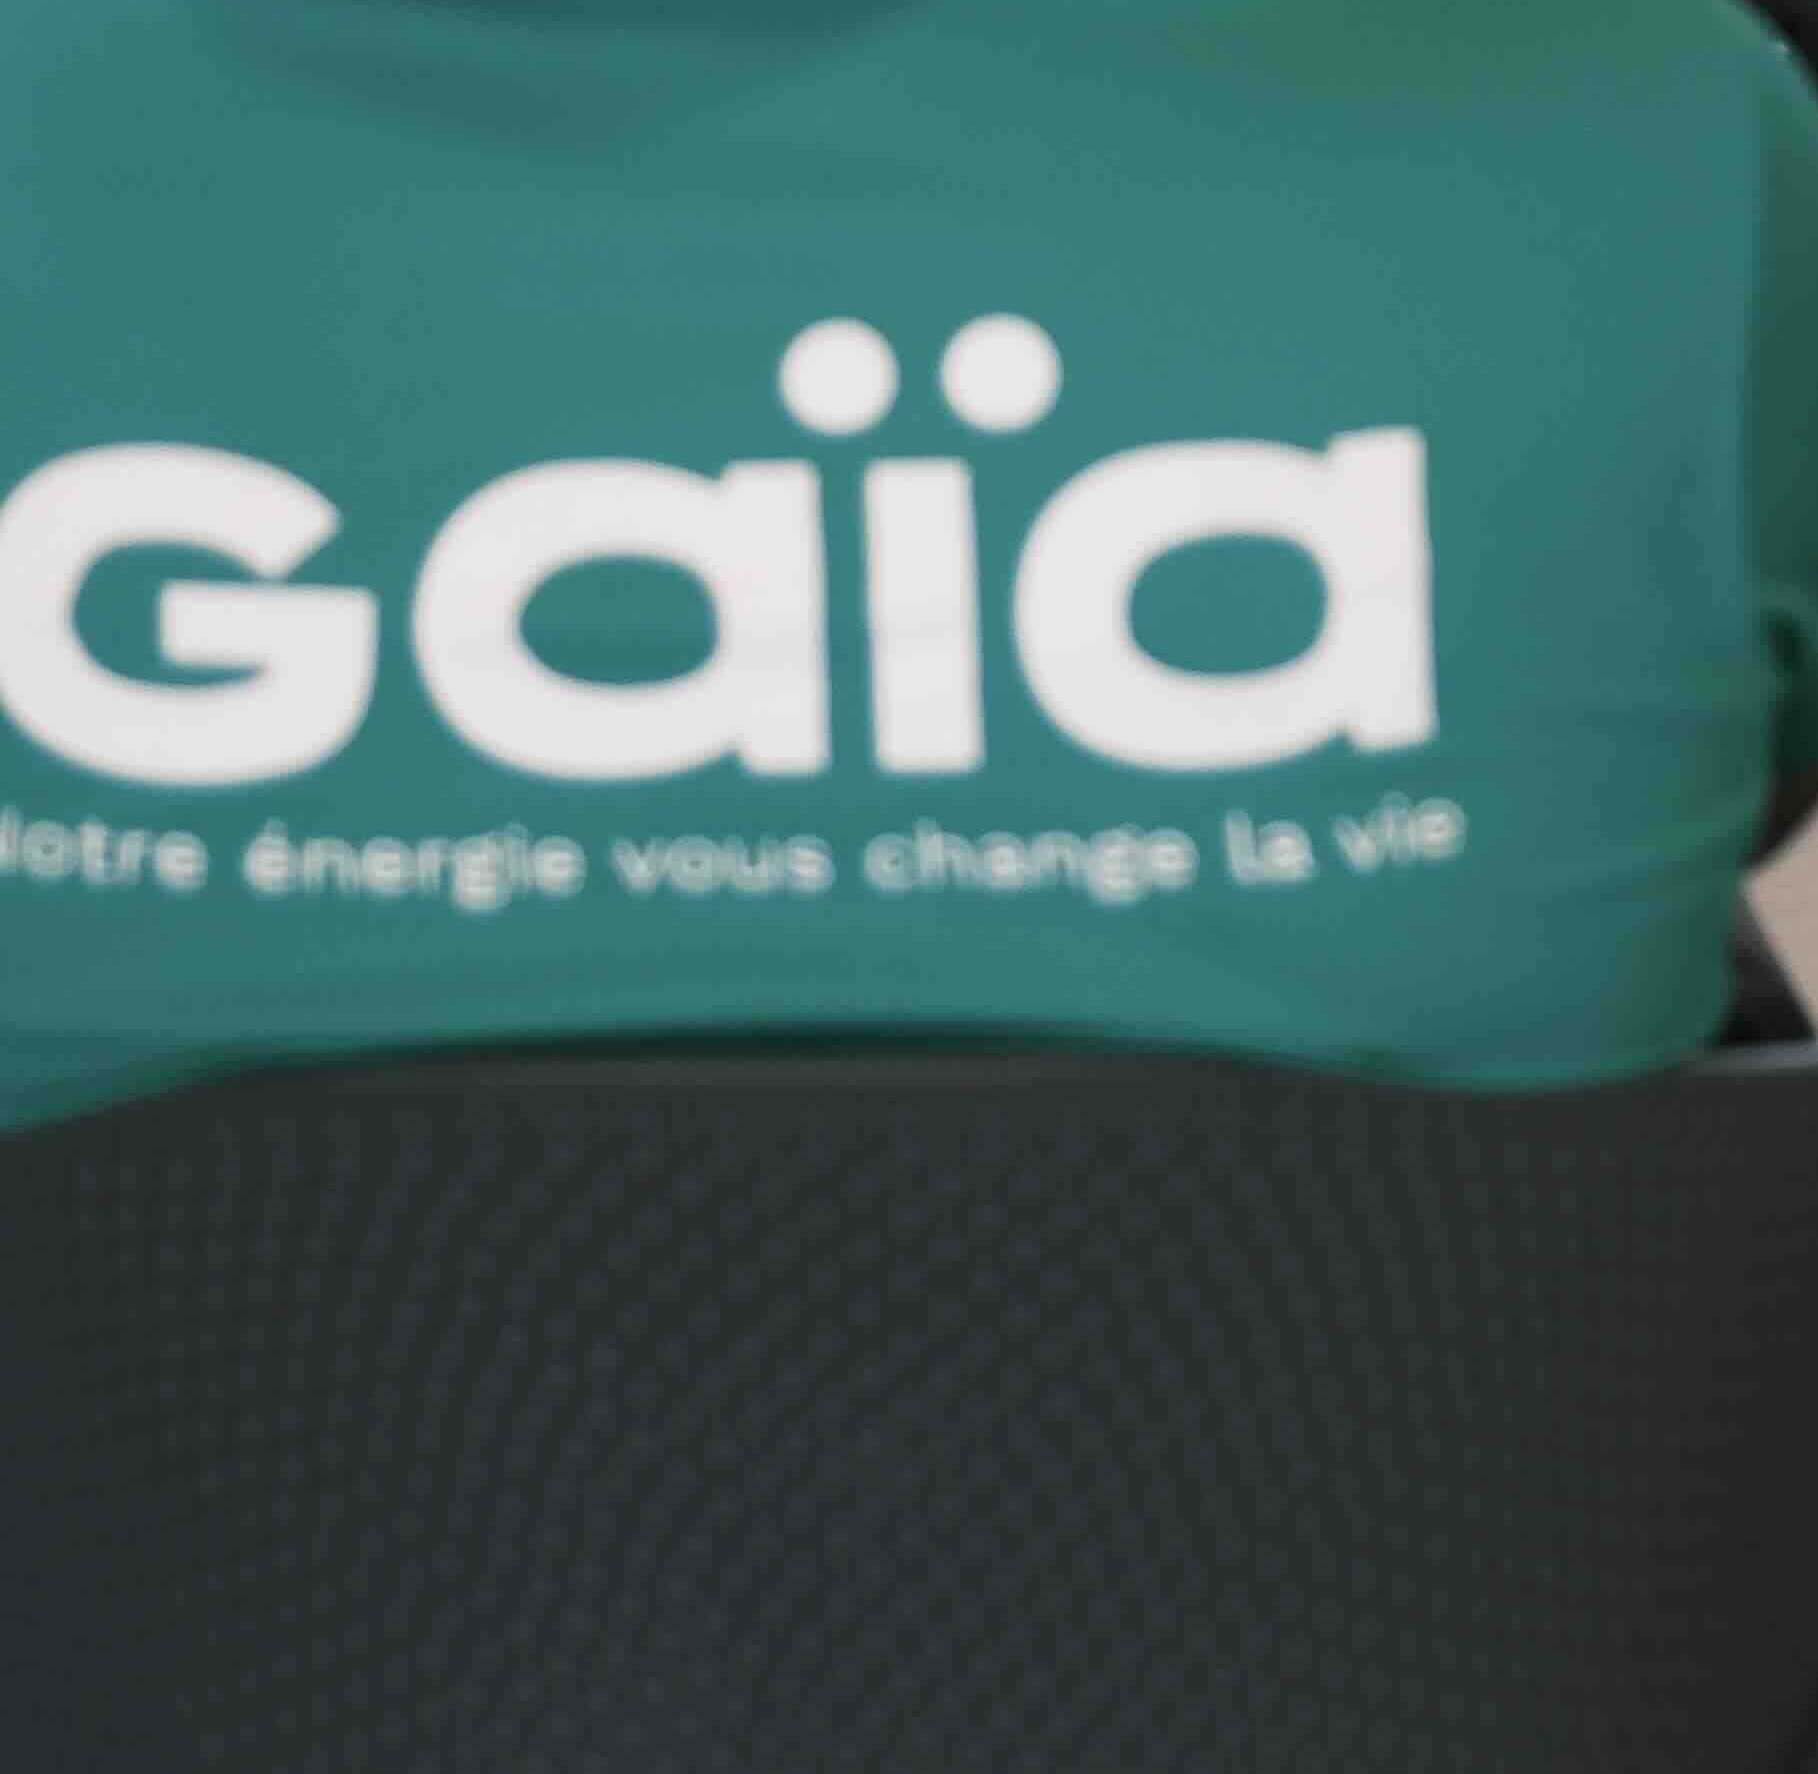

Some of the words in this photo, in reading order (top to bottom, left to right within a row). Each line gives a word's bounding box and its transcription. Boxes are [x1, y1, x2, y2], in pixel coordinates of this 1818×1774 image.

[0, 312, 1439, 787] Gaïa
[242, 818, 588, 913] énergie
[610, 832, 836, 895] vous
[862, 817, 1198, 909] change
[1223, 806, 1318, 887] la
[1330, 790, 1468, 874] vie
